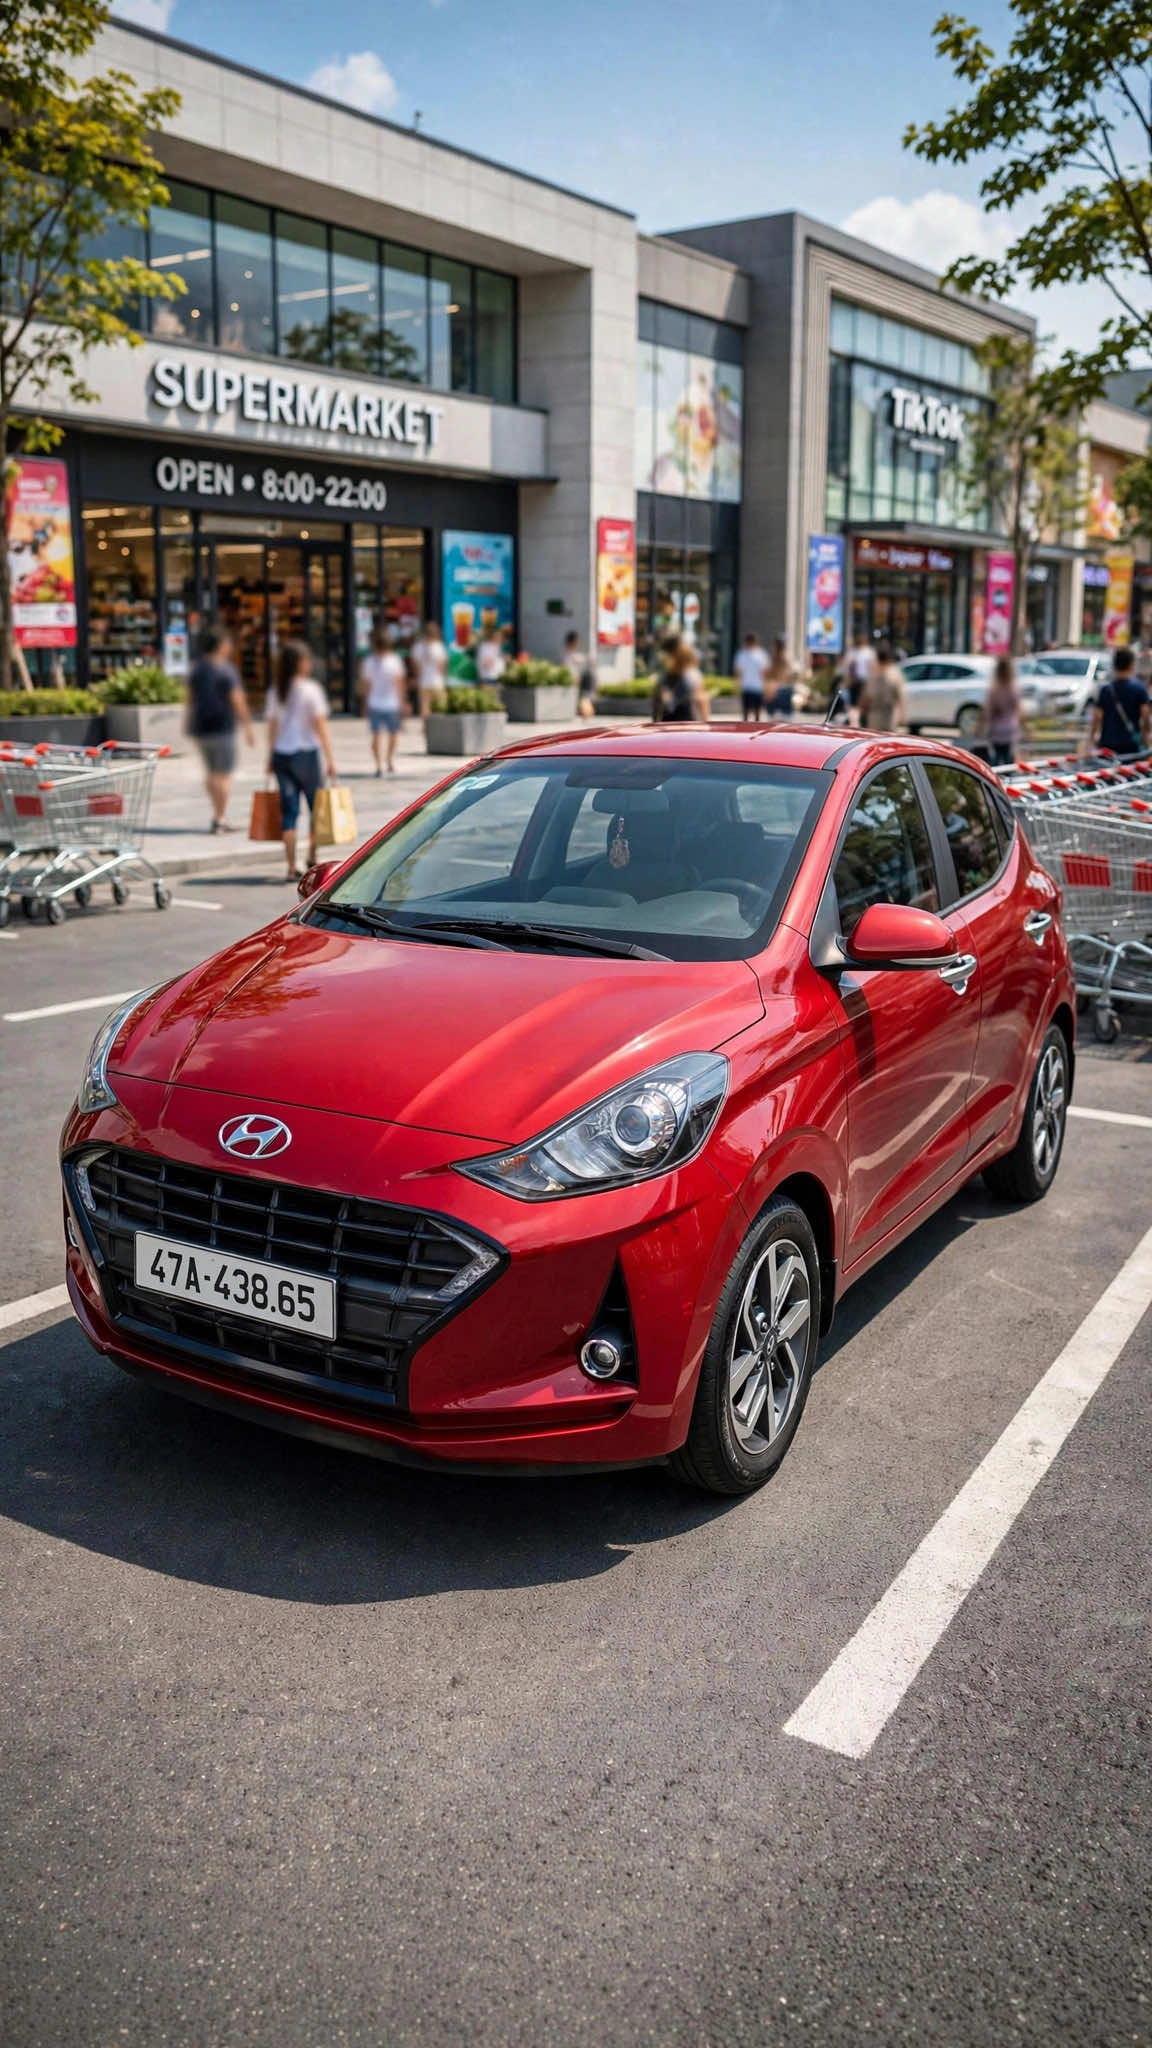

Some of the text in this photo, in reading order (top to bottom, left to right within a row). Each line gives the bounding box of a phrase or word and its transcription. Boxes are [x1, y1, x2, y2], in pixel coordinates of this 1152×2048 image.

[153, 360, 443, 444] SUPERMARKET
[891, 387, 965, 441] TikTok
[156, 456, 388, 511] OPEN 8:00-22:00
[150, 1249, 316, 1322] 47A-438.65
